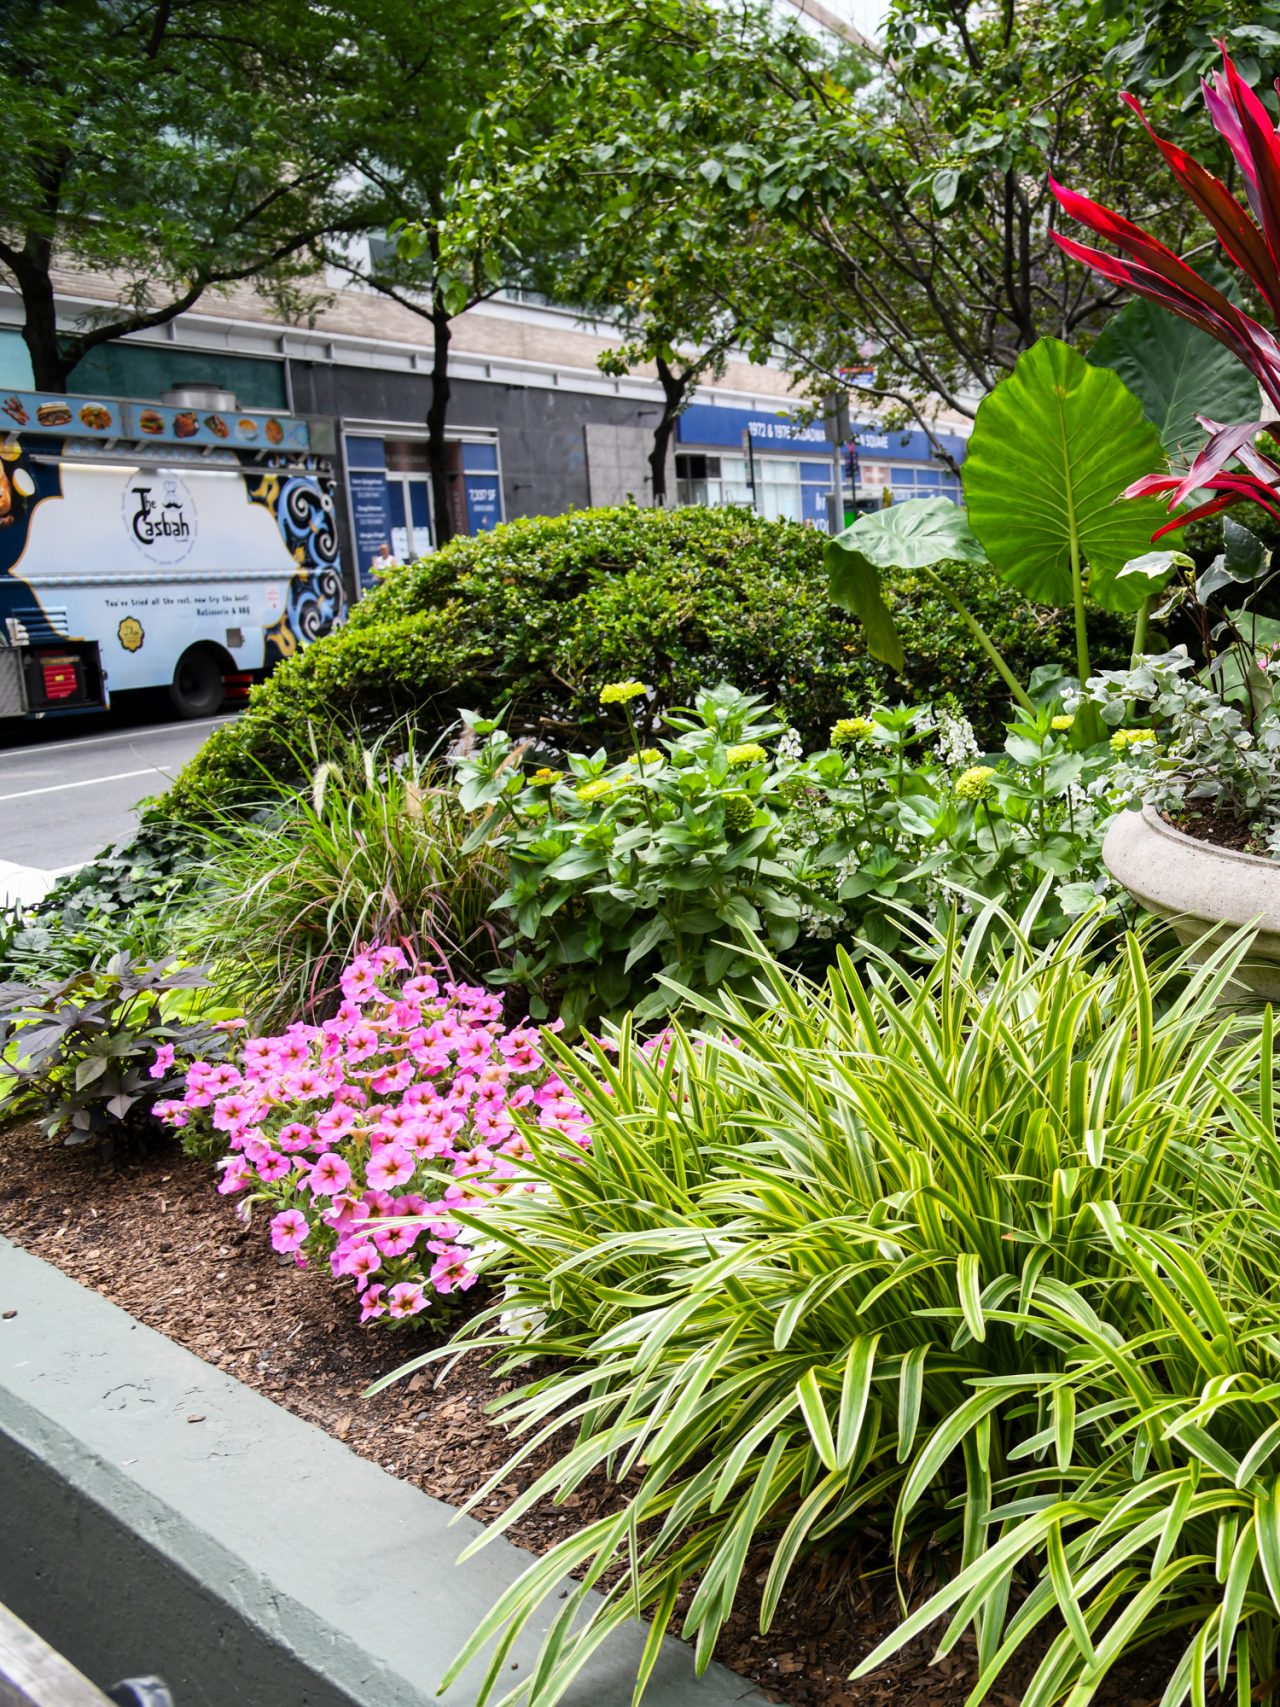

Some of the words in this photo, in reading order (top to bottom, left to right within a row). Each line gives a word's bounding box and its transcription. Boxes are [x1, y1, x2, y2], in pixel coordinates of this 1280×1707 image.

[748, 422, 766, 437] 1972
[767, 424, 774, 438] &
[792, 427, 827, 442] BROADWA
[131, 488, 156, 514] The
[133, 510, 189, 545] Casbah
[131, 598, 148, 606] tried
